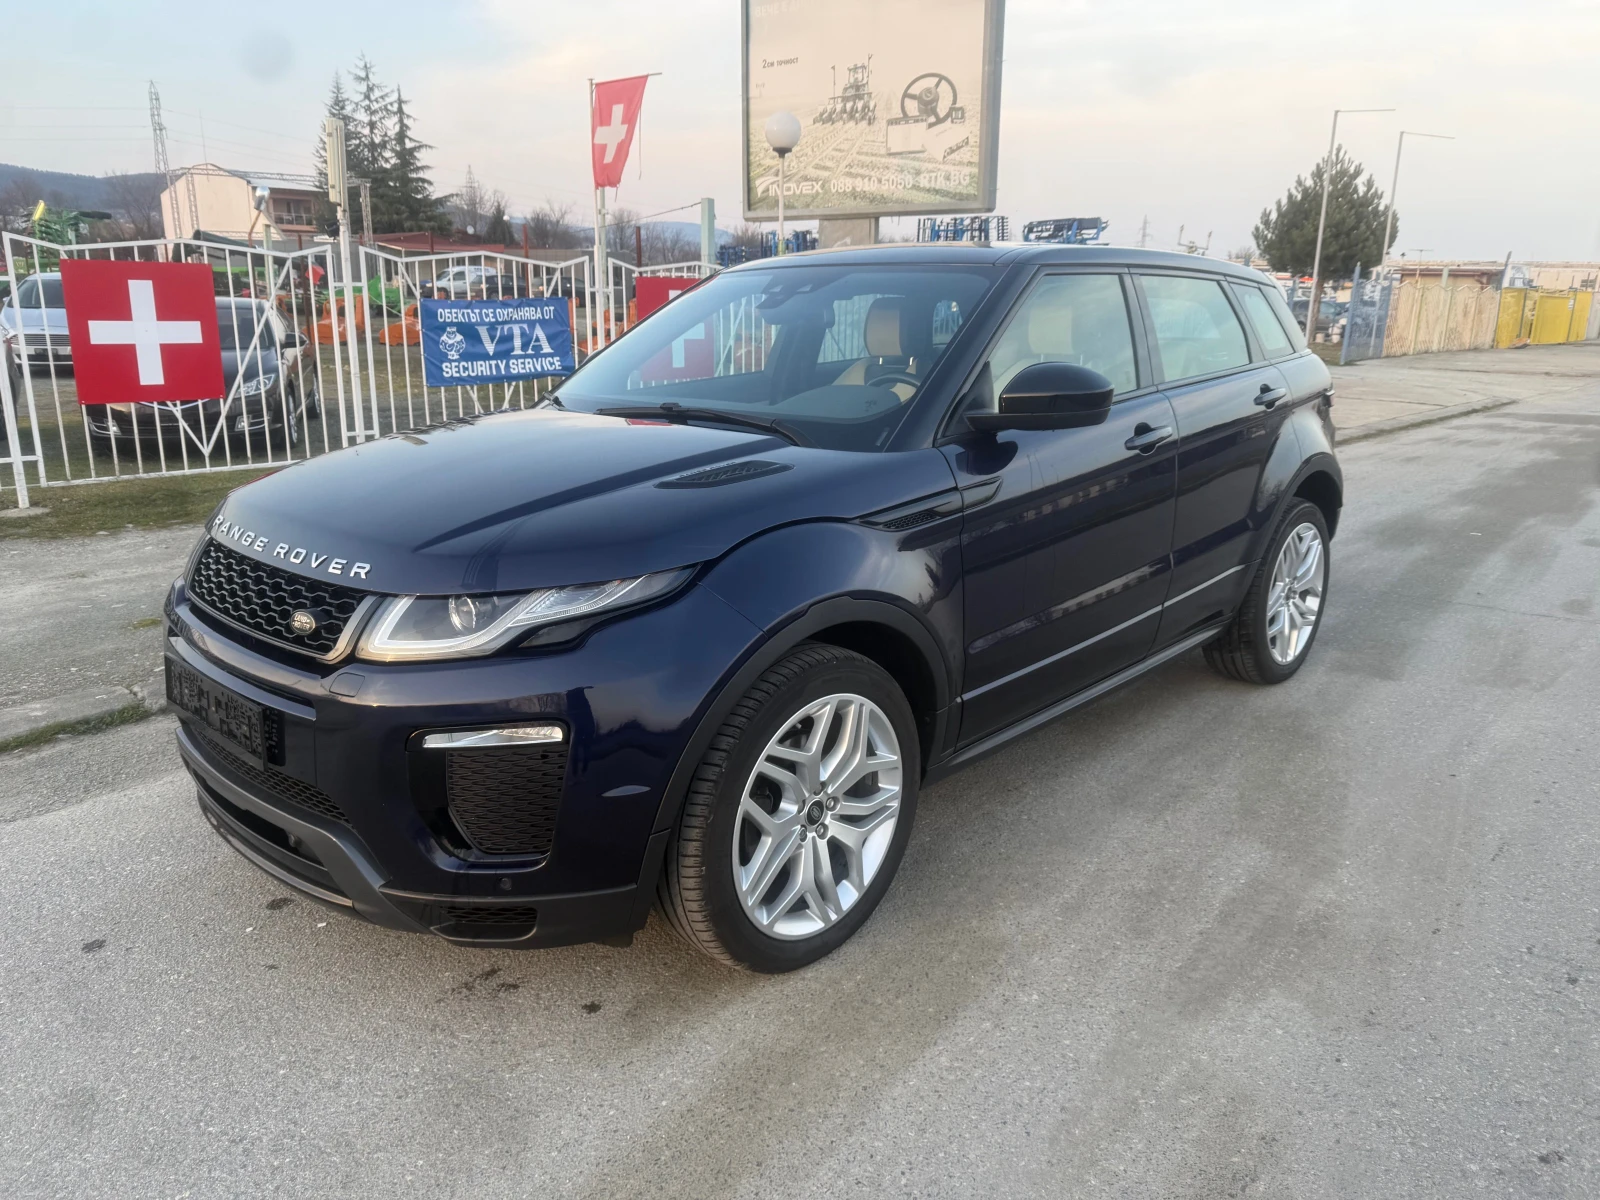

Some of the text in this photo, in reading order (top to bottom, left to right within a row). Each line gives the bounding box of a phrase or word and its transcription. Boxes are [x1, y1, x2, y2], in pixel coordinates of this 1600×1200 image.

[769, 180, 823, 196] INOVEX
[830, 174, 913, 193] 088 910 5050
[920, 171, 970, 188] RTK.BG
[437, 306, 555, 323] ОБЕКТЪТ СЕ ОХРАНЯВА ОТ
[475, 322, 554, 356] VTA
[442, 356, 562, 378] SECURITY SERVICE
[212, 515, 372, 579] RANGE ROVER
